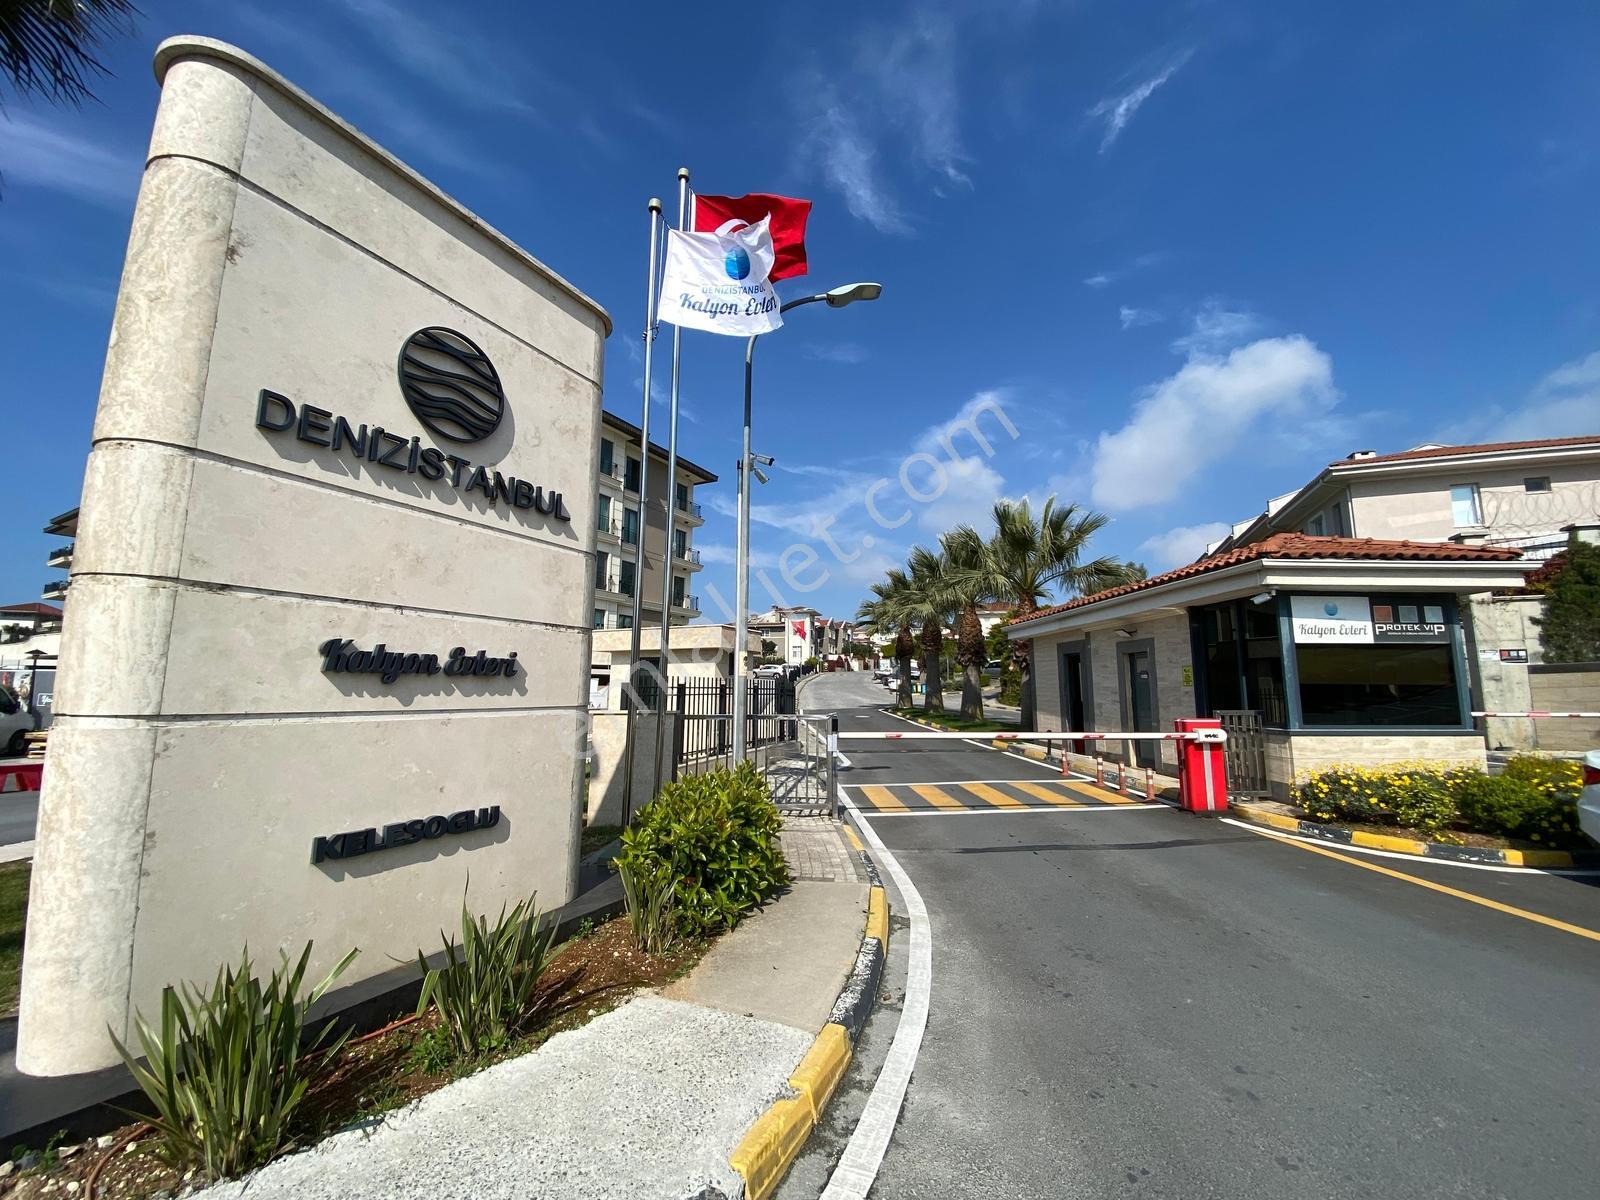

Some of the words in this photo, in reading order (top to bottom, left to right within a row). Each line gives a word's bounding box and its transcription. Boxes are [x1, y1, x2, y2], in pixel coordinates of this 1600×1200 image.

[680, 293, 738, 319] Kalyon
[1299, 623, 1337, 638] Kalyon
[1339, 623, 1367, 635] Evleri
[1375, 624, 1420, 635] PROTEK
[1422, 624, 1445, 635] VIP
[318, 638, 442, 684] Kalyon
[443, 646, 519, 677] Evleri
